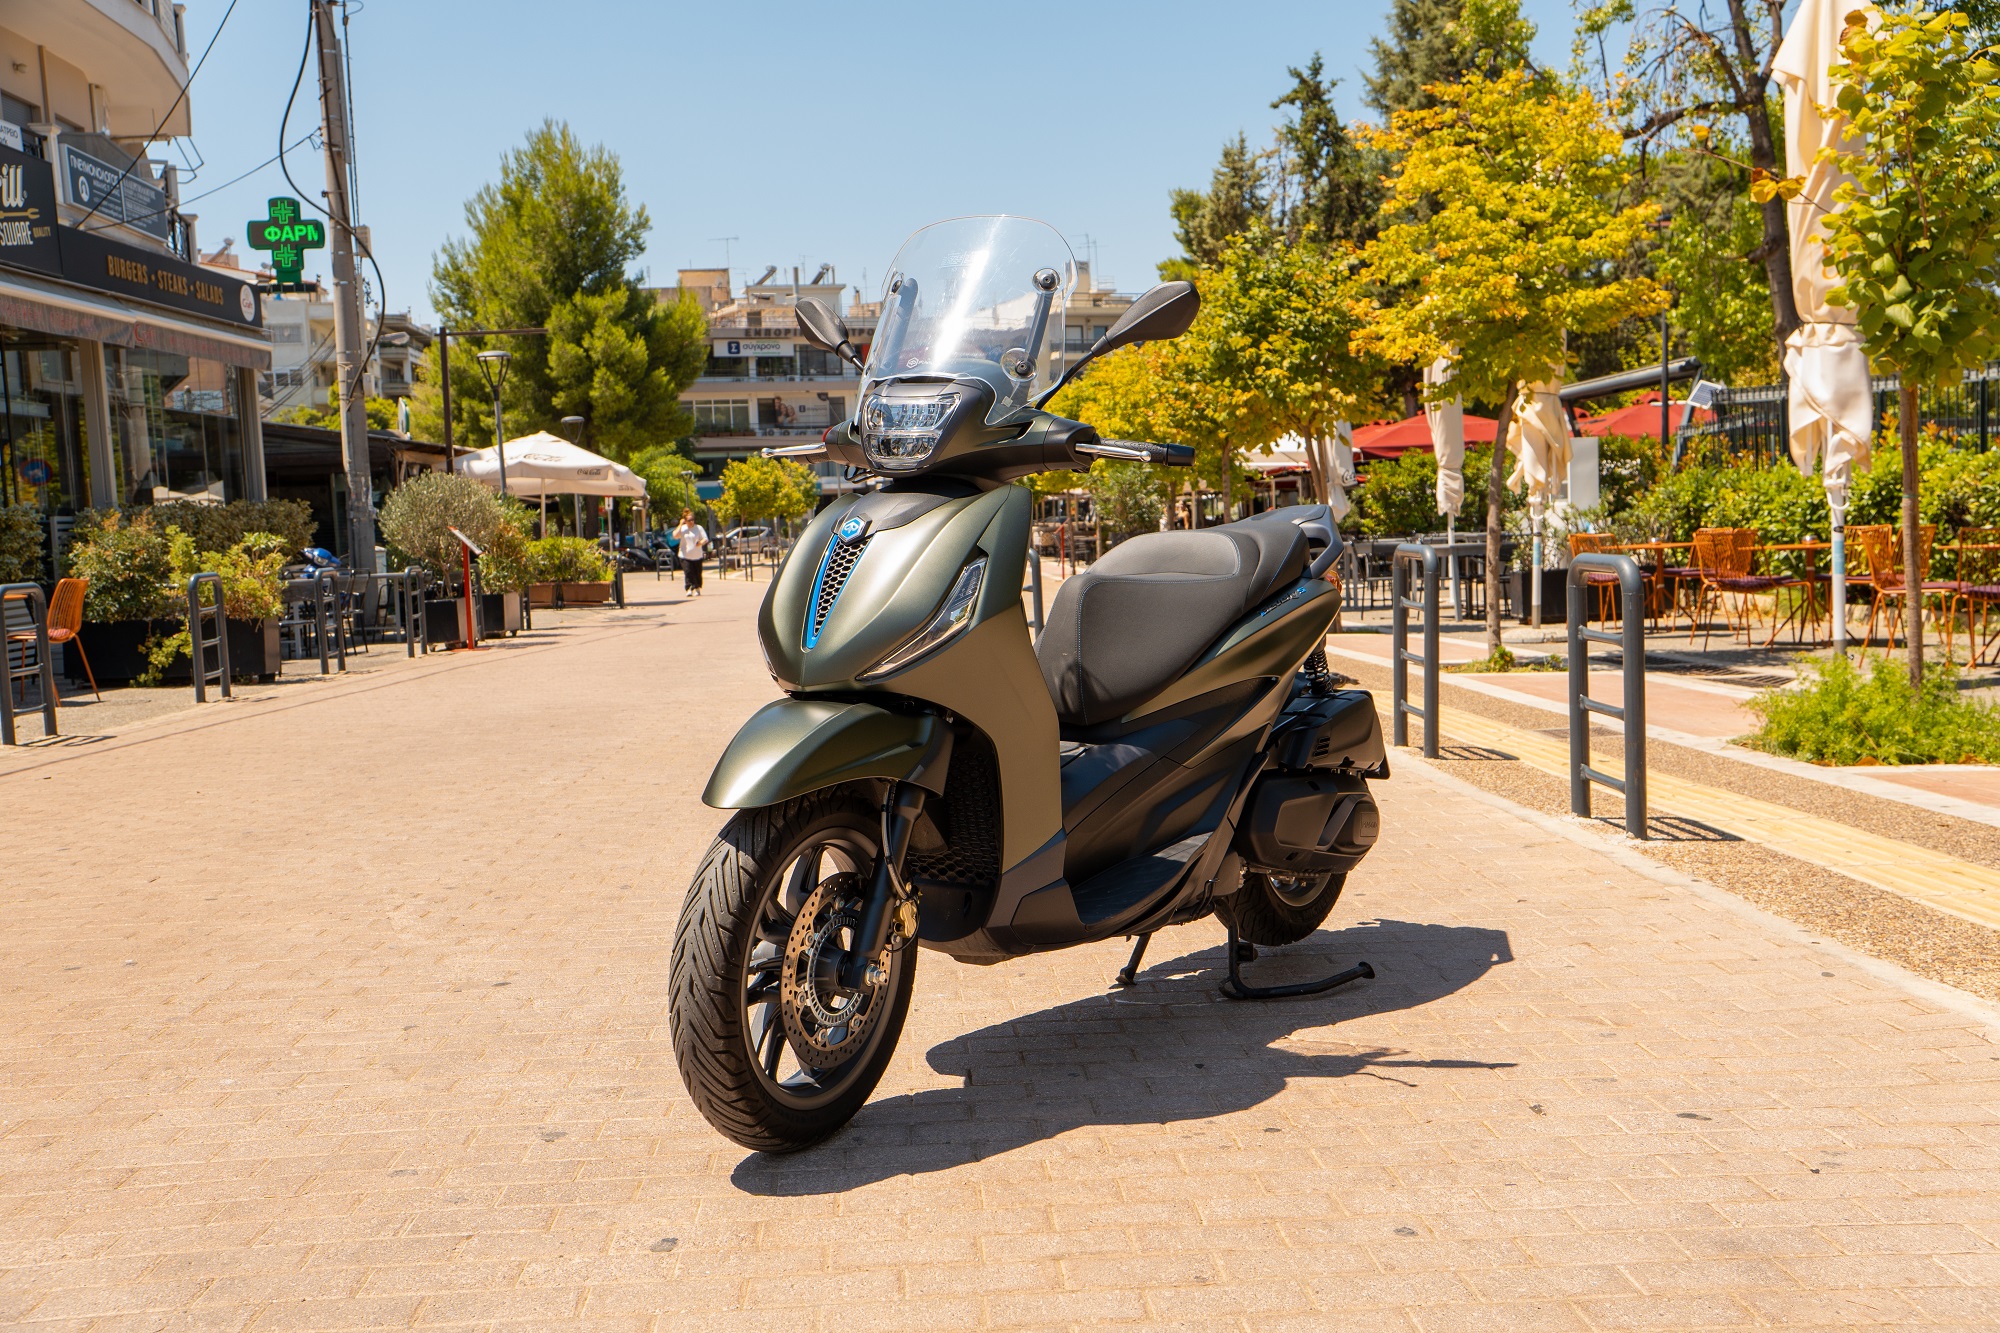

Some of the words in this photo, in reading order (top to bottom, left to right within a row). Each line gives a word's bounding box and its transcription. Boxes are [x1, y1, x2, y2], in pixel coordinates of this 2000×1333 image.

[0, 163, 25, 208] ill
[107, 255, 148, 285] BURGERS
[157, 270, 188, 296] STEAKS
[195, 280, 224, 305] SALADS
